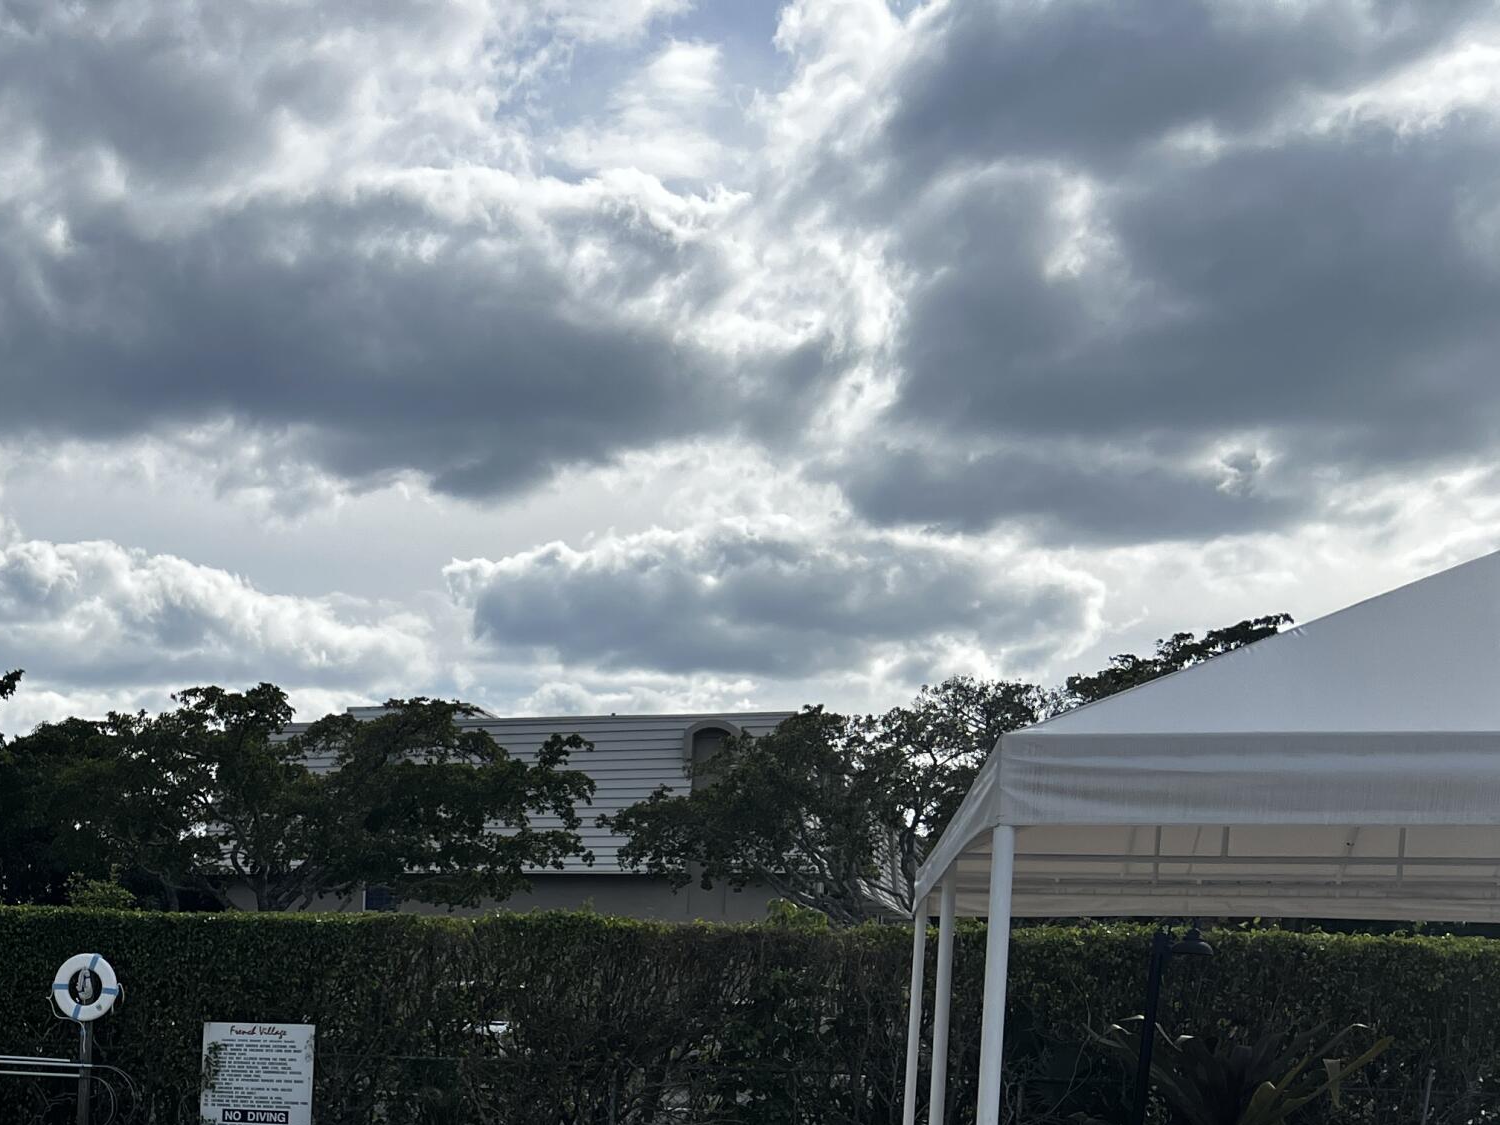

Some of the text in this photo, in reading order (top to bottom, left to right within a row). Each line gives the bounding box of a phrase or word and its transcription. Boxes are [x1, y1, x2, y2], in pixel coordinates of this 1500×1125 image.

[230, 1025, 287, 1039] French Village
[224, 1110, 286, 1123] NO DIVING
